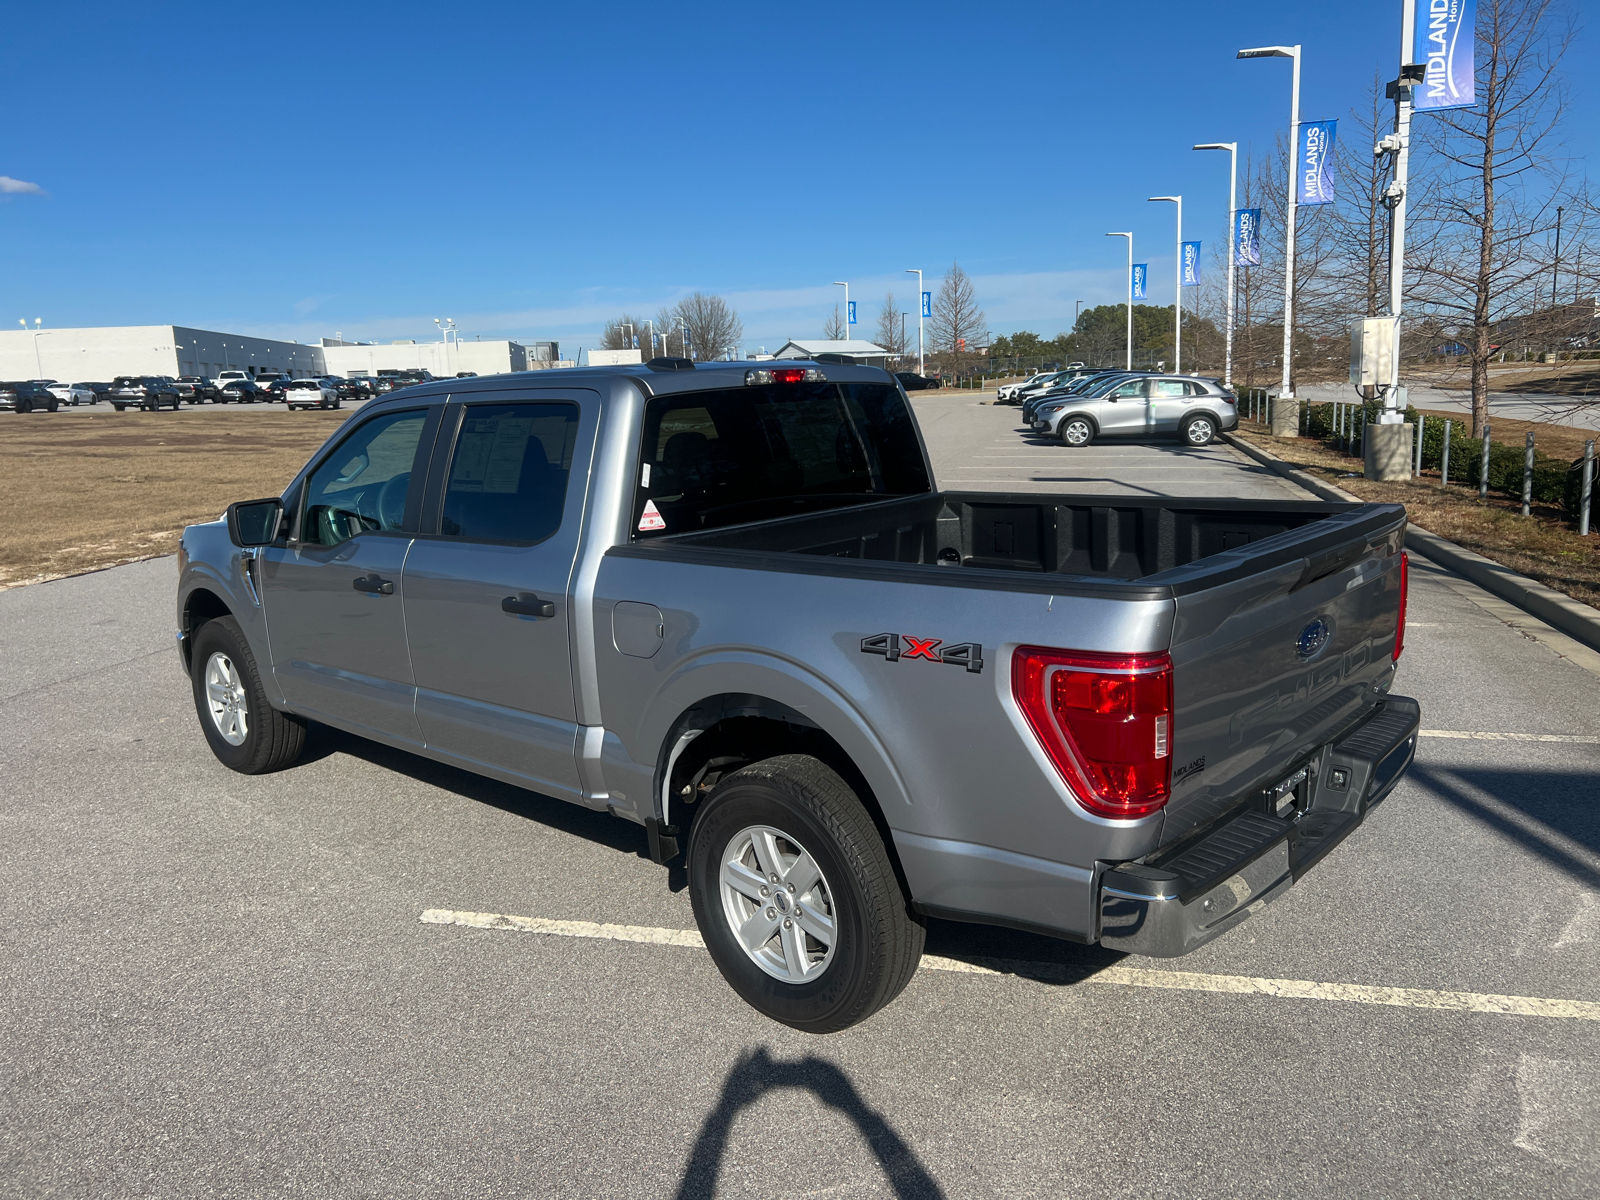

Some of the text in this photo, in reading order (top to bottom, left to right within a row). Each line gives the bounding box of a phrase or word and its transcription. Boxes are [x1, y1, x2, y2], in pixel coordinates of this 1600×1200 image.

[1448, 0, 1458, 22] Hon
[1305, 127, 1319, 197] MIDLANDS
[1173, 755, 1206, 779] MIDLANDS
